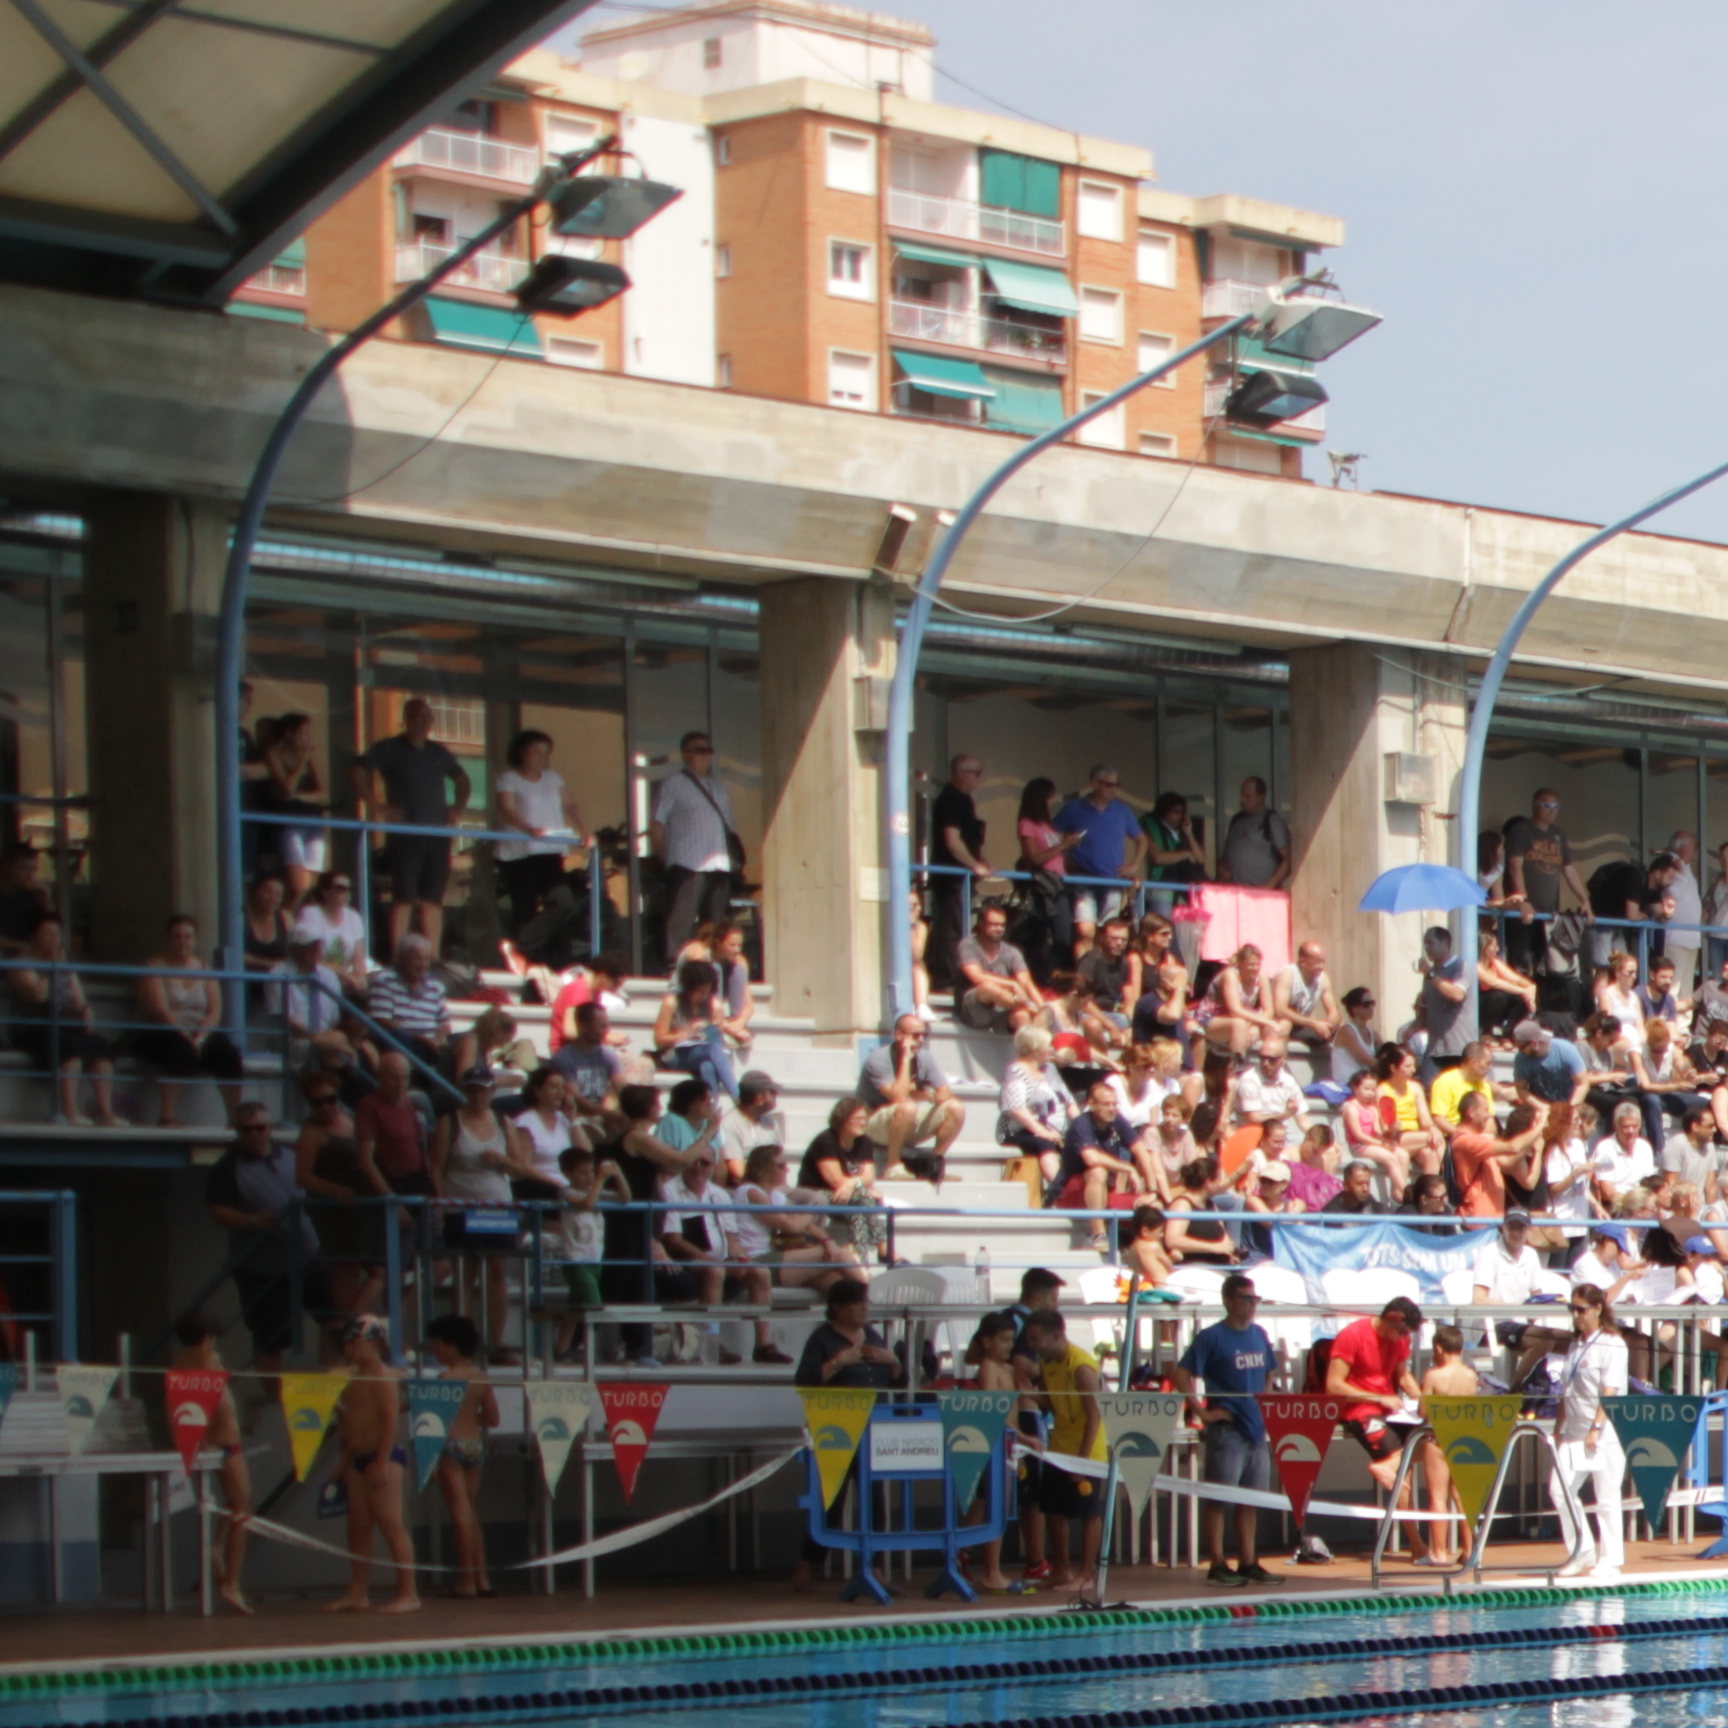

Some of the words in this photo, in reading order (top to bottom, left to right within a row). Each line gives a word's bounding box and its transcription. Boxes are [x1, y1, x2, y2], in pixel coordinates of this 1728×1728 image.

[1235, 1352, 1266, 1370] CNM
[169, 1375, 224, 1392] TURBO
[408, 1383, 464, 1403] TURBO
[603, 1391, 664, 1409] TURBO
[939, 1395, 1011, 1414] TURBO
[1101, 1401, 1178, 1418] TURBO
[1263, 1402, 1340, 1420] TURBO
[1608, 1403, 1697, 1422] TURBO
